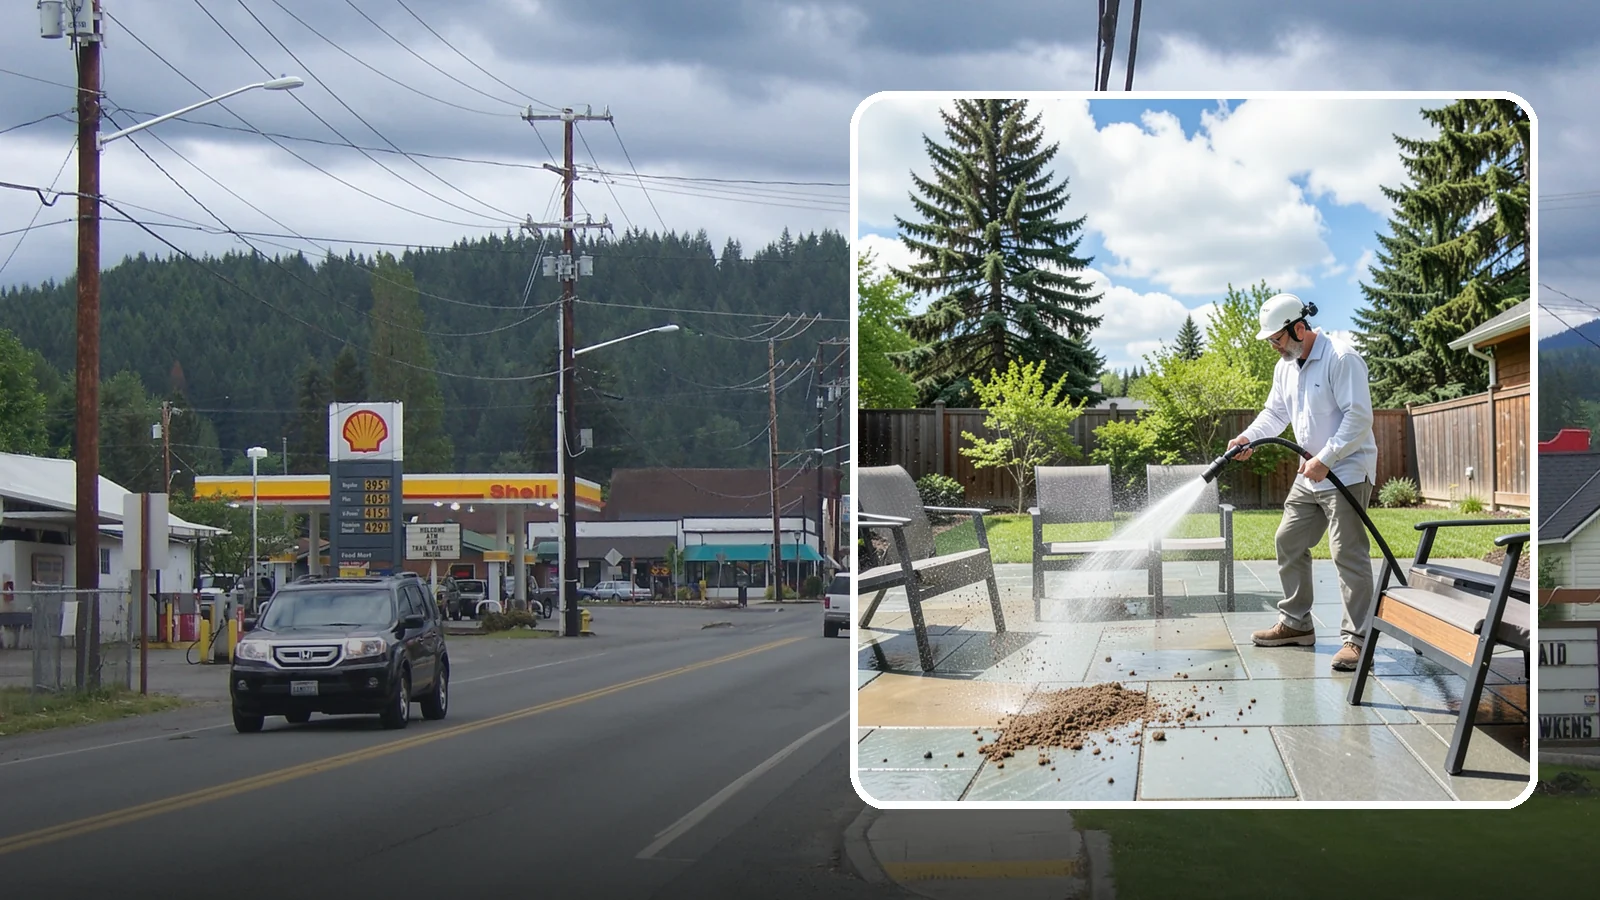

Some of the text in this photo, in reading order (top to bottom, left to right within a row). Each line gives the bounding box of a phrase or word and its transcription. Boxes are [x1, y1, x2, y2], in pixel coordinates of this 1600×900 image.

[366, 479, 383, 490] 395
[490, 484, 547, 499] Shell
[366, 494, 383, 504] 405
[365, 508, 383, 518] 415
[366, 522, 383, 533] 429
